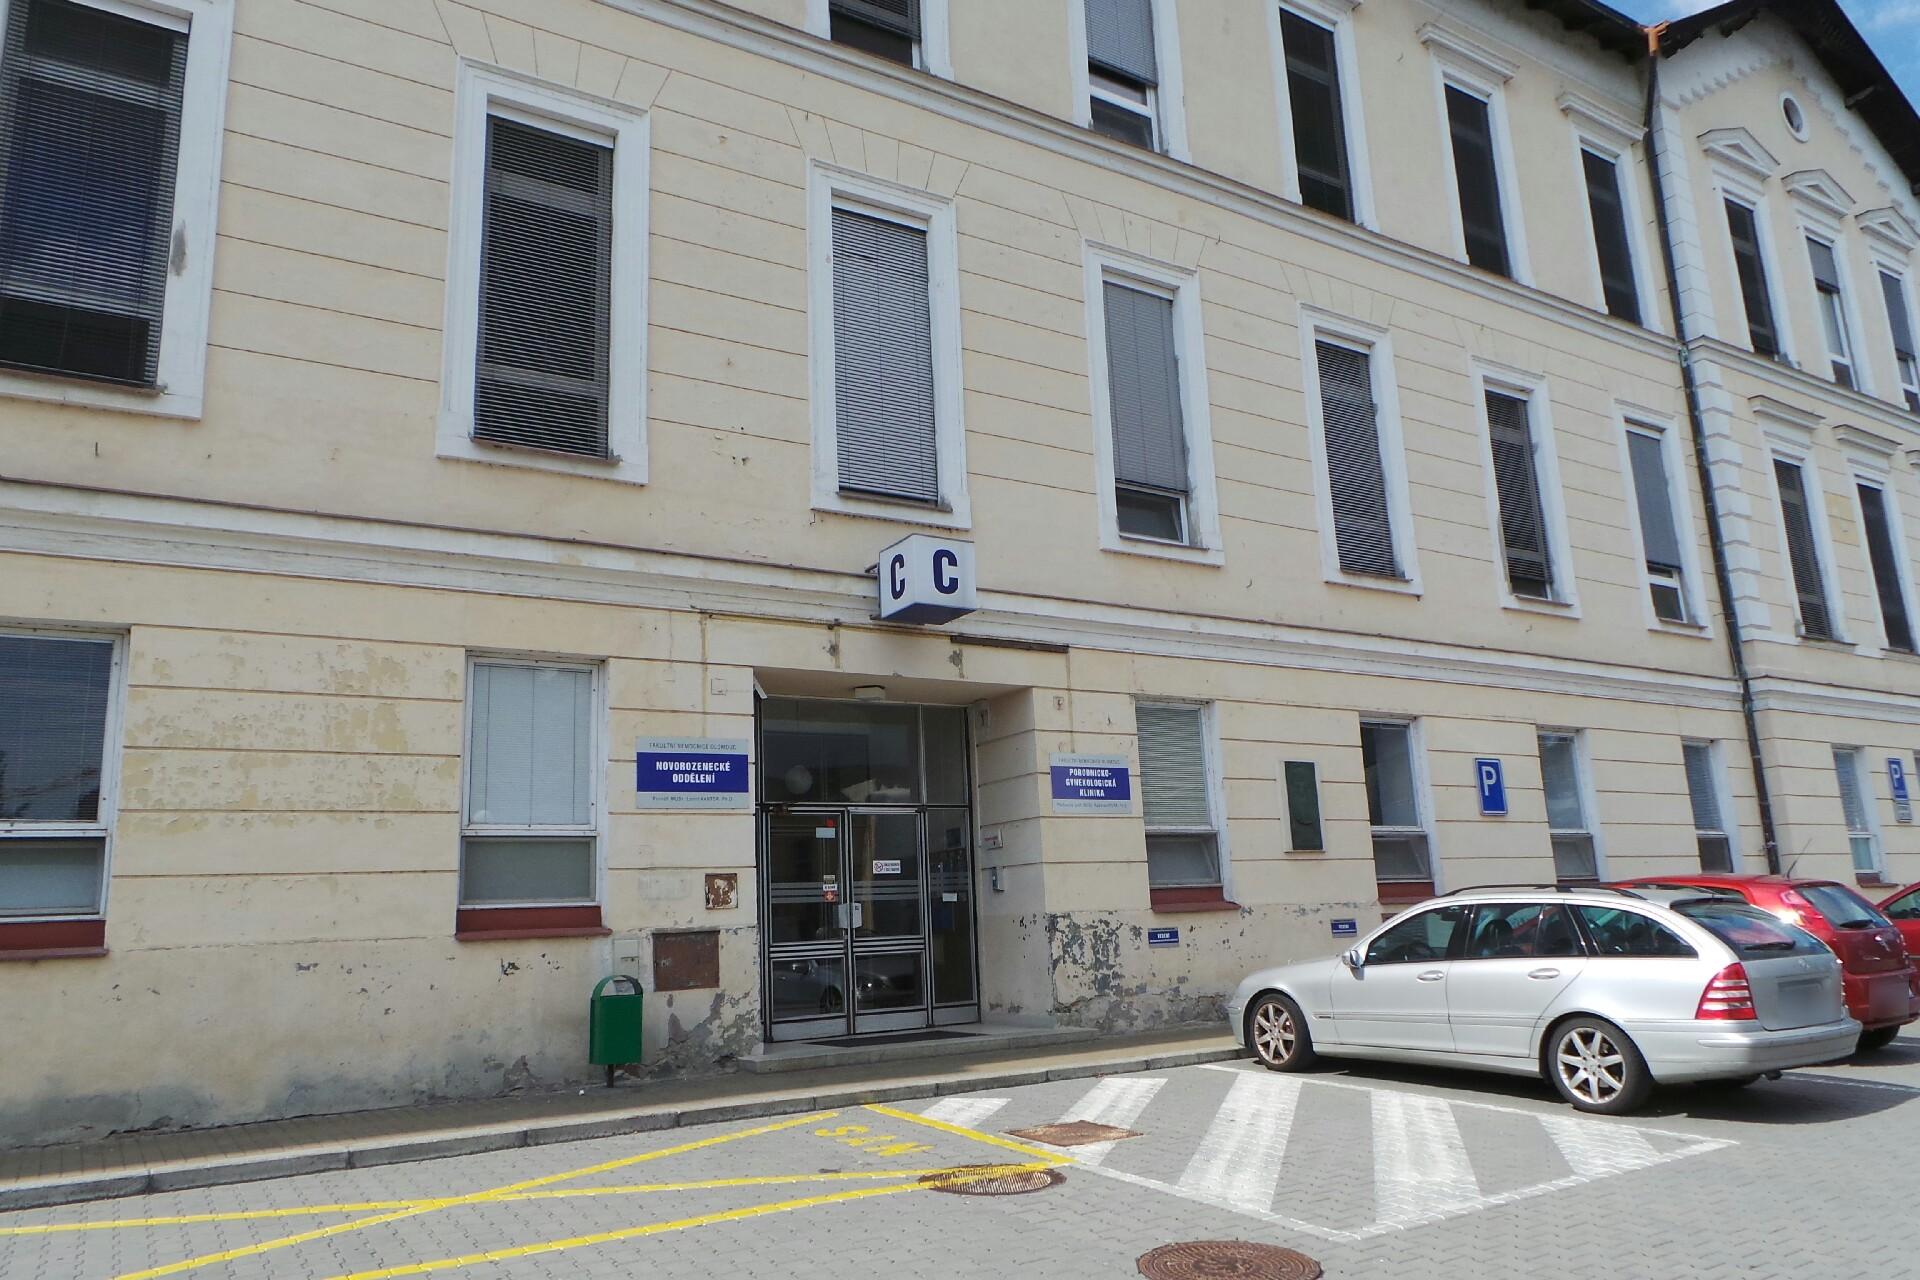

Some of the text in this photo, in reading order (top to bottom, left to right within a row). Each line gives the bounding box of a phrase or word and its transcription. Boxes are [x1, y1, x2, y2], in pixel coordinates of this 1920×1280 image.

[891, 554, 905, 600] C
[933, 549, 958, 594] C
[656, 761, 731, 771] NOVOROZENECKÉ
[672, 772, 715, 783] ODDĚLENÍ
[1069, 768, 1112, 777] PORODNICKO-
[1890, 764, 1901, 787] P
[1065, 778, 1117, 787] GYNEKOLOGICKÁ
[1481, 766, 1497, 796] P
[1079, 789, 1105, 797] KLINIKA
